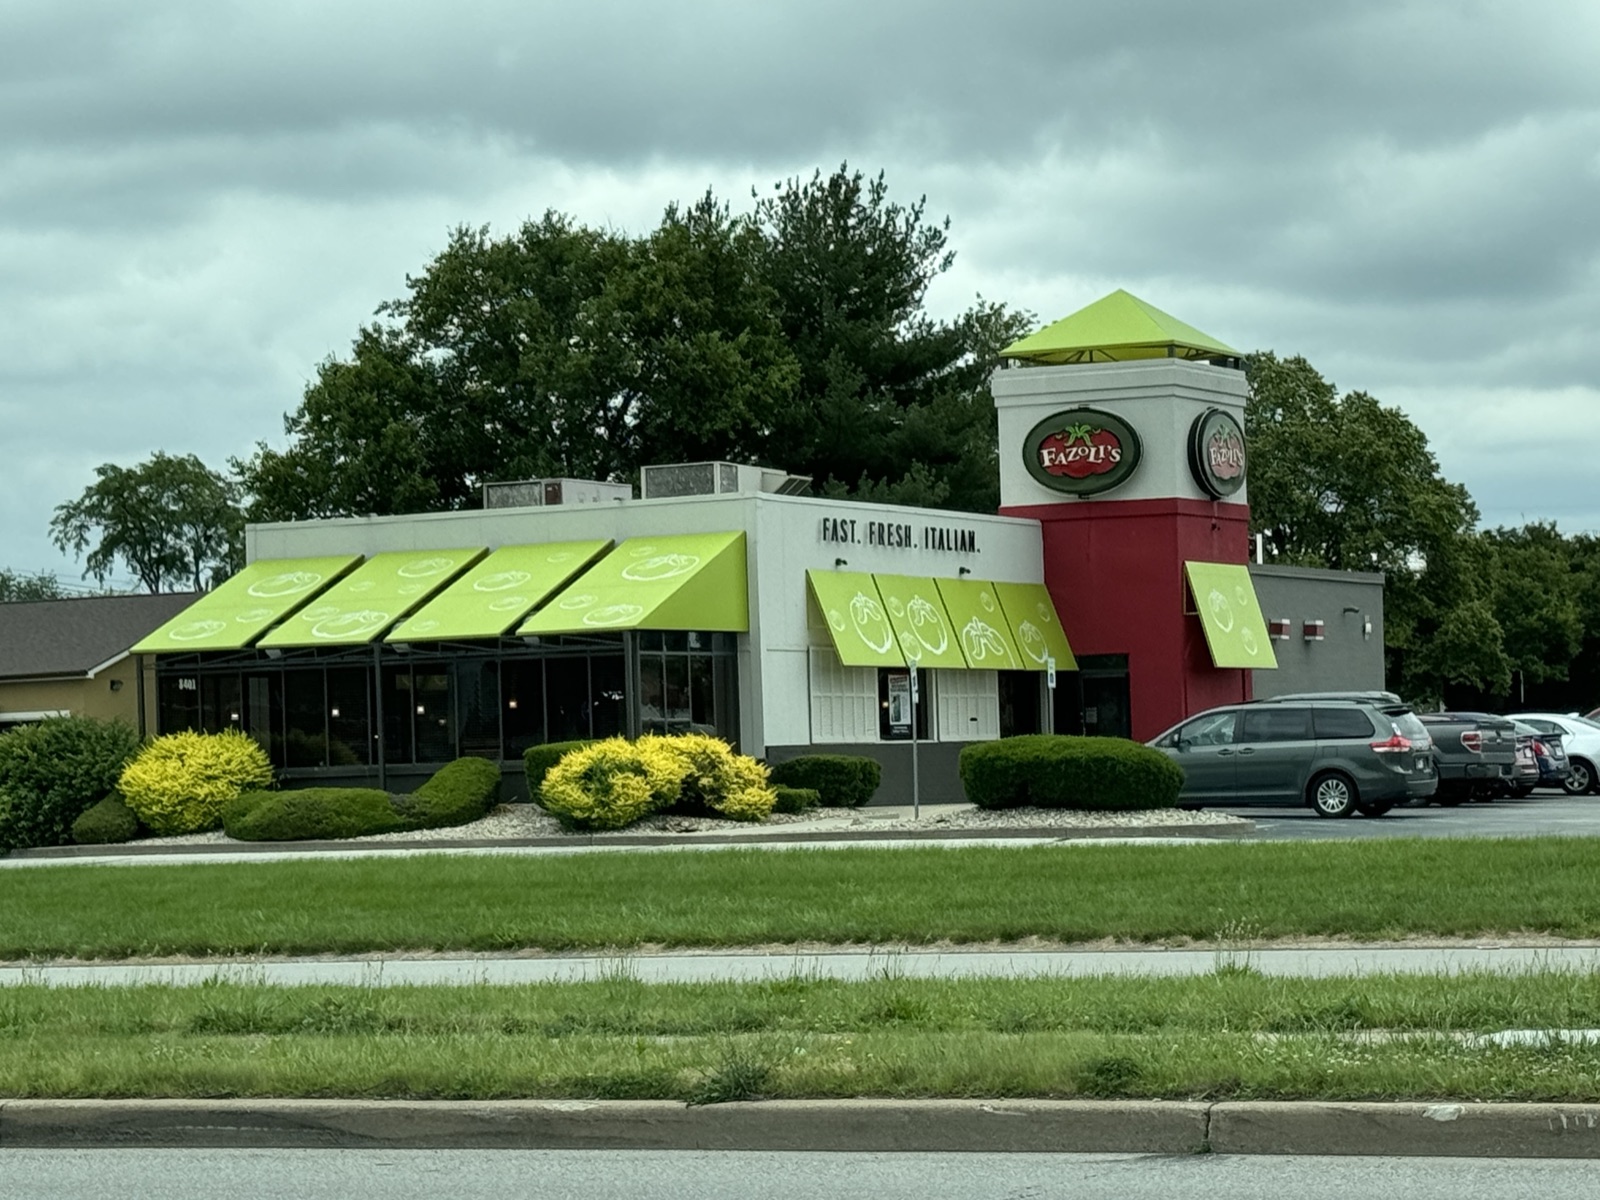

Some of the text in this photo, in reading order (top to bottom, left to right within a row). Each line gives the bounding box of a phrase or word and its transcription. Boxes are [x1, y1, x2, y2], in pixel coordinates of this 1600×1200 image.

[1040, 444, 1122, 467] FAZOLI'S
[822, 517, 981, 553] FAST. FRESH. ITALIAN.
